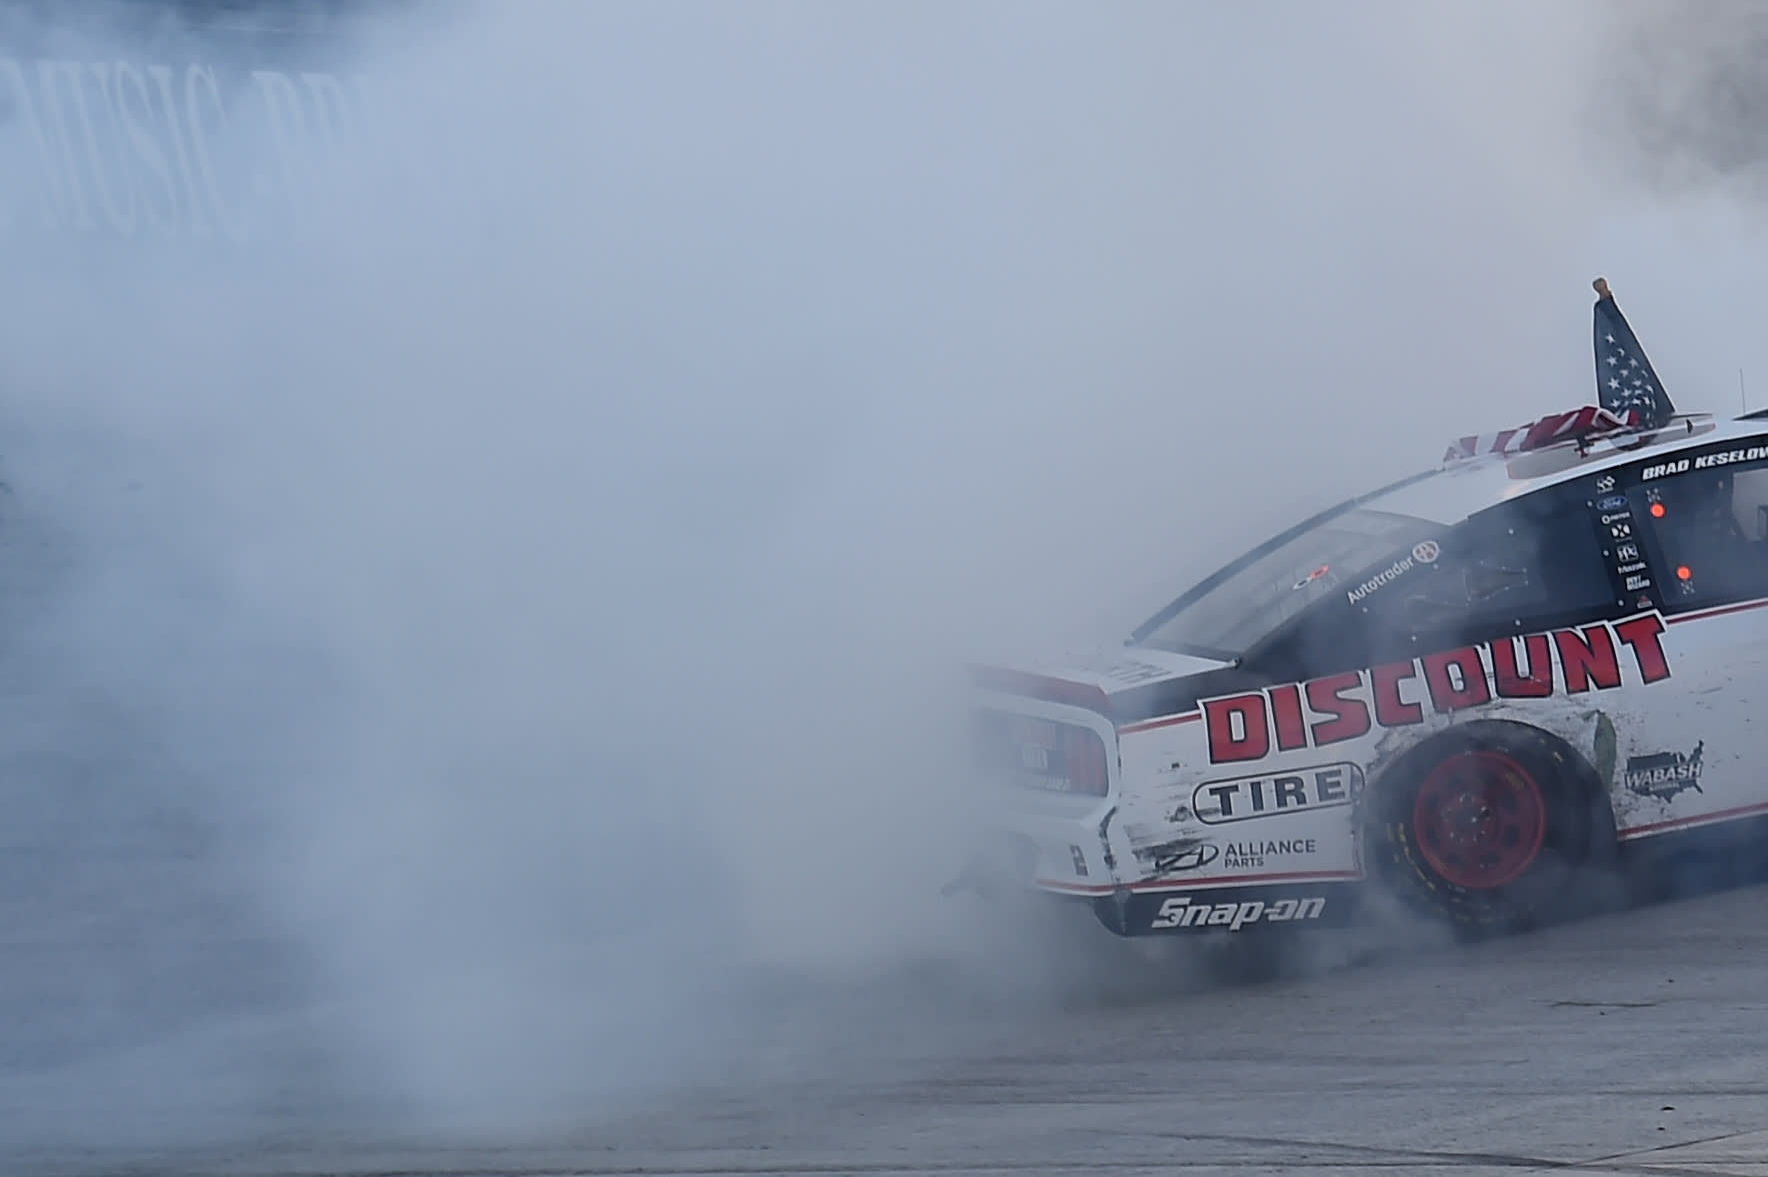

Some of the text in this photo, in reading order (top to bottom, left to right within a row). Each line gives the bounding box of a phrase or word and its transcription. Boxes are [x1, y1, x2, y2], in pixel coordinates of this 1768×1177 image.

[1642, 459, 1690, 481] BRAD
[1347, 557, 1414, 604] Autotrader
[1202, 613, 1671, 764] DISCOUNT
[1625, 763, 1702, 788] WABASH
[1209, 767, 1348, 817] TIRE
[1225, 839, 1316, 858] ALLIANCE
[1225, 857, 1265, 869] PARTS
[1151, 897, 1326, 932] Snap-on
